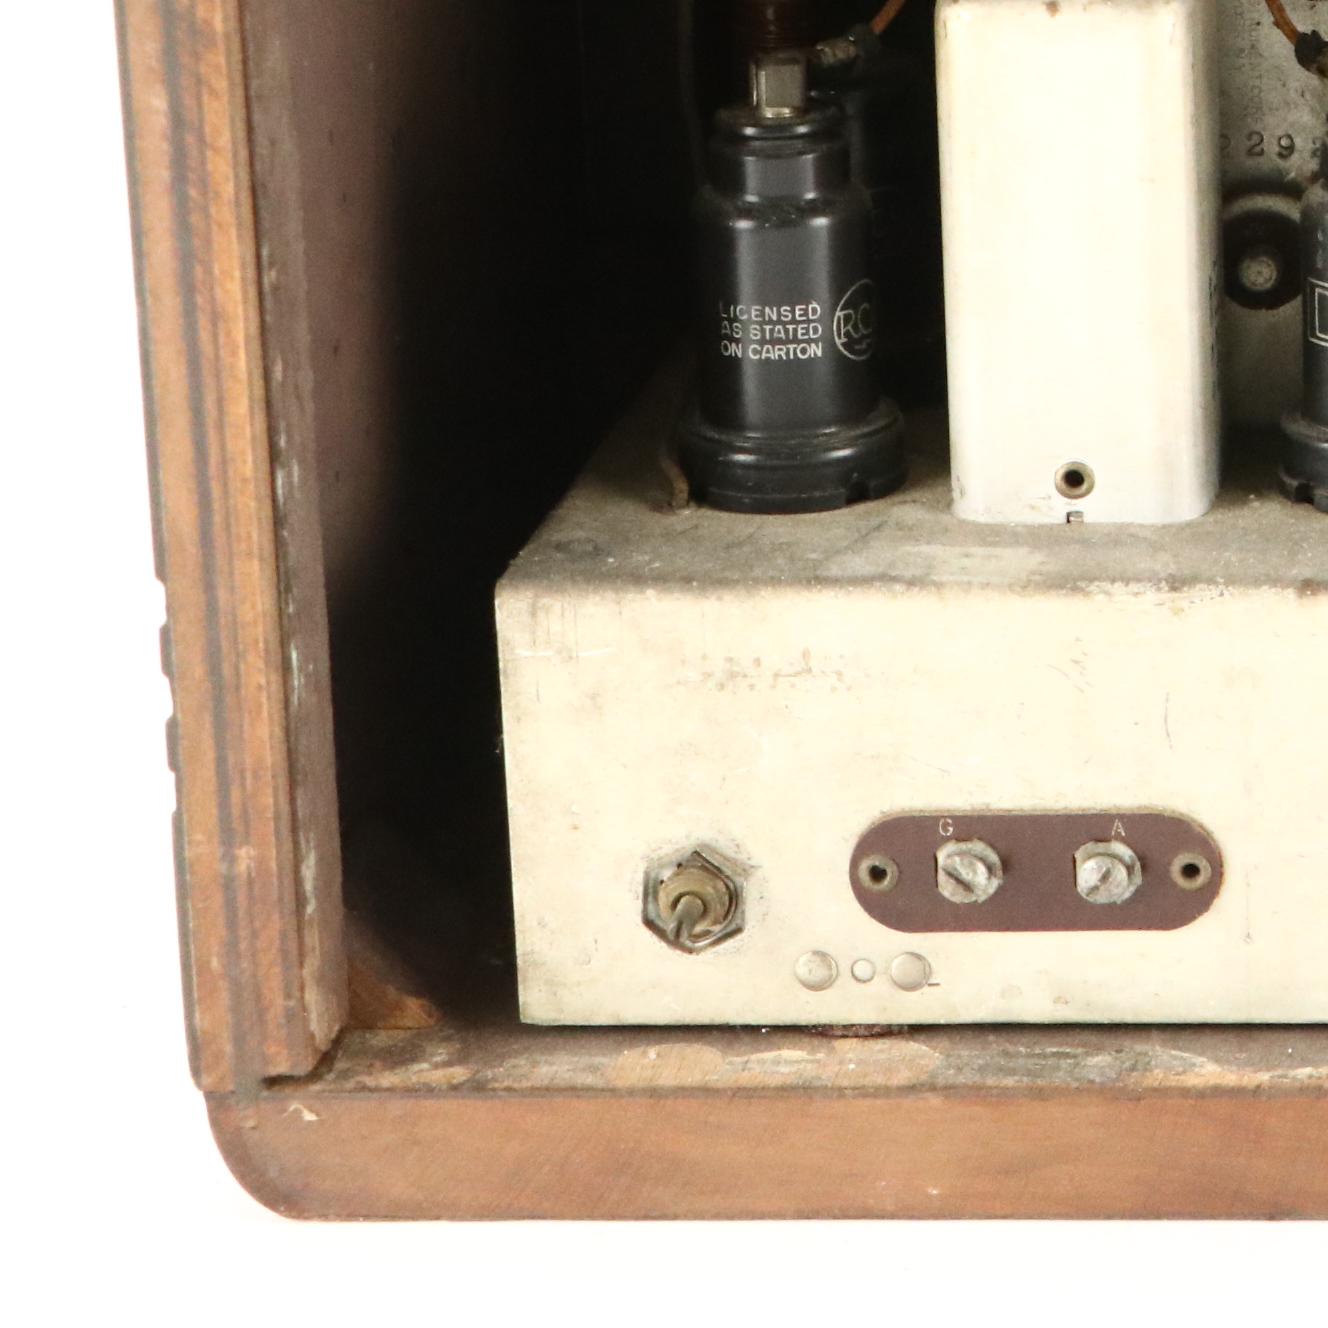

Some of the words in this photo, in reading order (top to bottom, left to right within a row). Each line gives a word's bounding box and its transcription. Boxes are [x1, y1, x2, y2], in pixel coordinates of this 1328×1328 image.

[719, 302, 822, 322] LICENSED
[721, 321, 743, 338] AS
[749, 323, 822, 340] STATED
[720, 340, 742, 358] ON
[748, 342, 823, 360] CARTON
[938, 818, 954, 837] G
[1111, 818, 1126, 838] A
